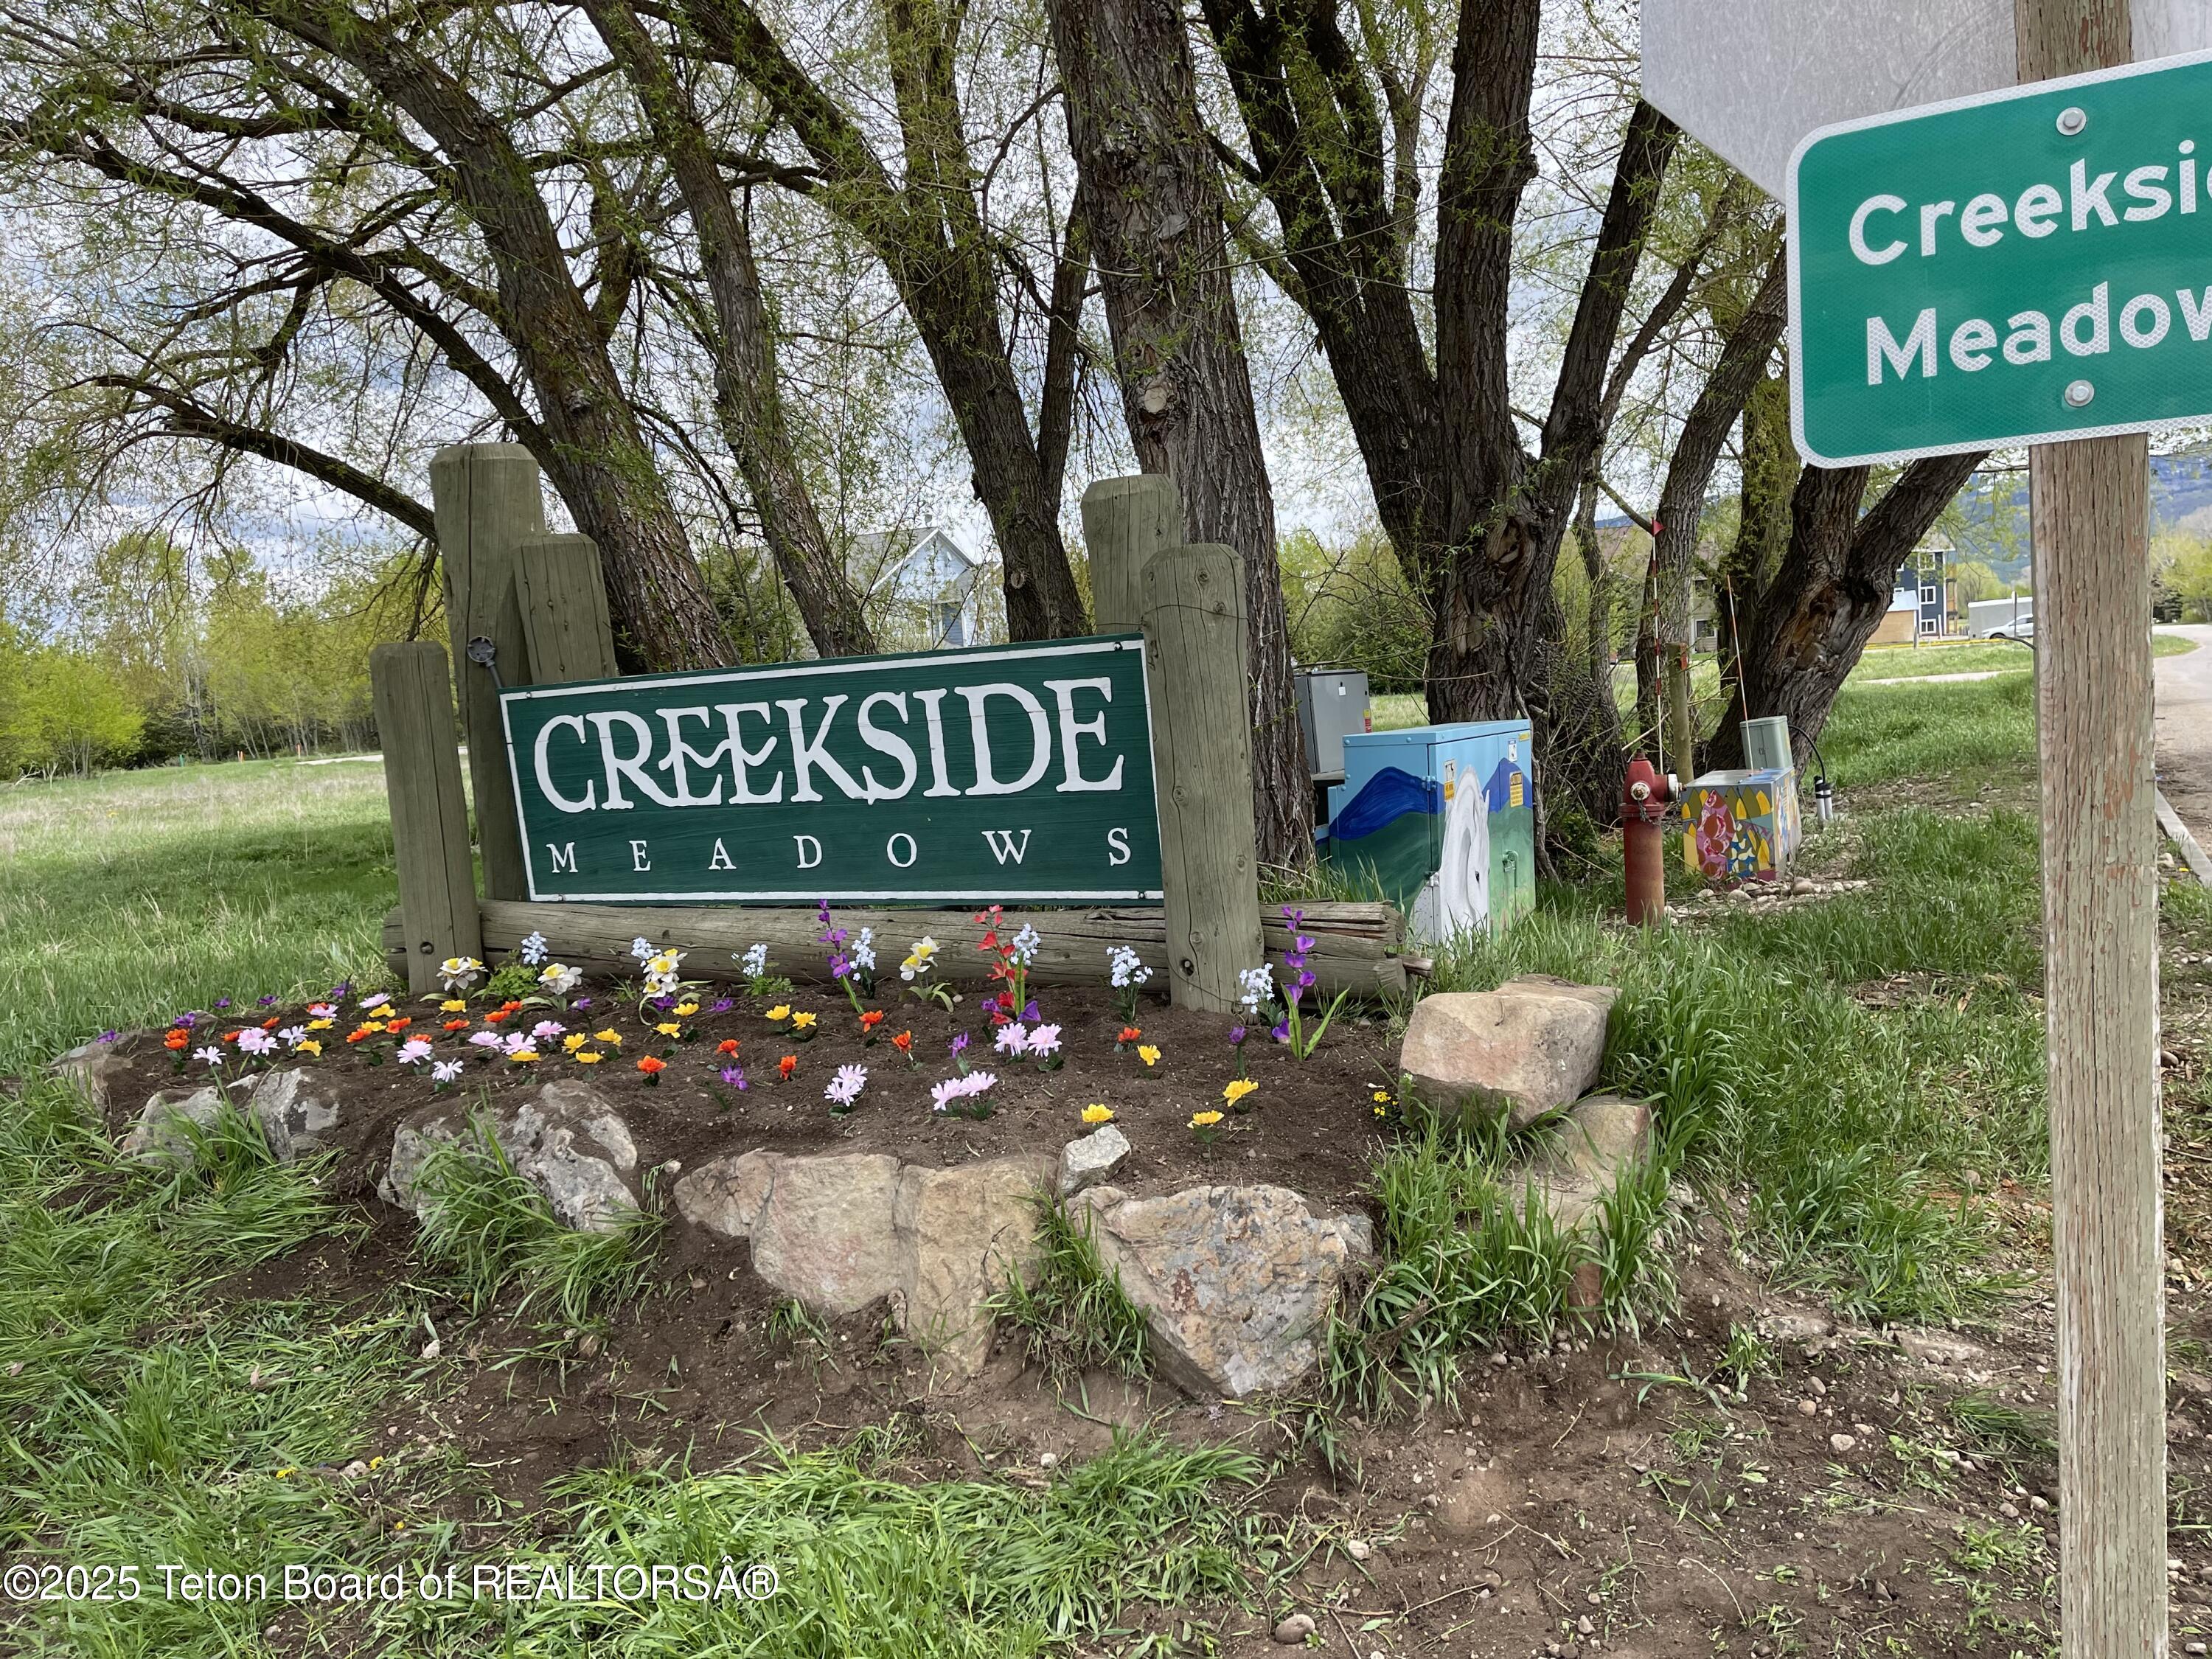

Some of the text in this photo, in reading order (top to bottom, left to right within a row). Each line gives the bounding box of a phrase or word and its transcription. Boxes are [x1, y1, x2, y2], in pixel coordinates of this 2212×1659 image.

[1848, 139, 2212, 265] Creeksi
[534, 676, 1124, 813] CREEKSIDE
[545, 827, 1132, 874] MEADOWS
